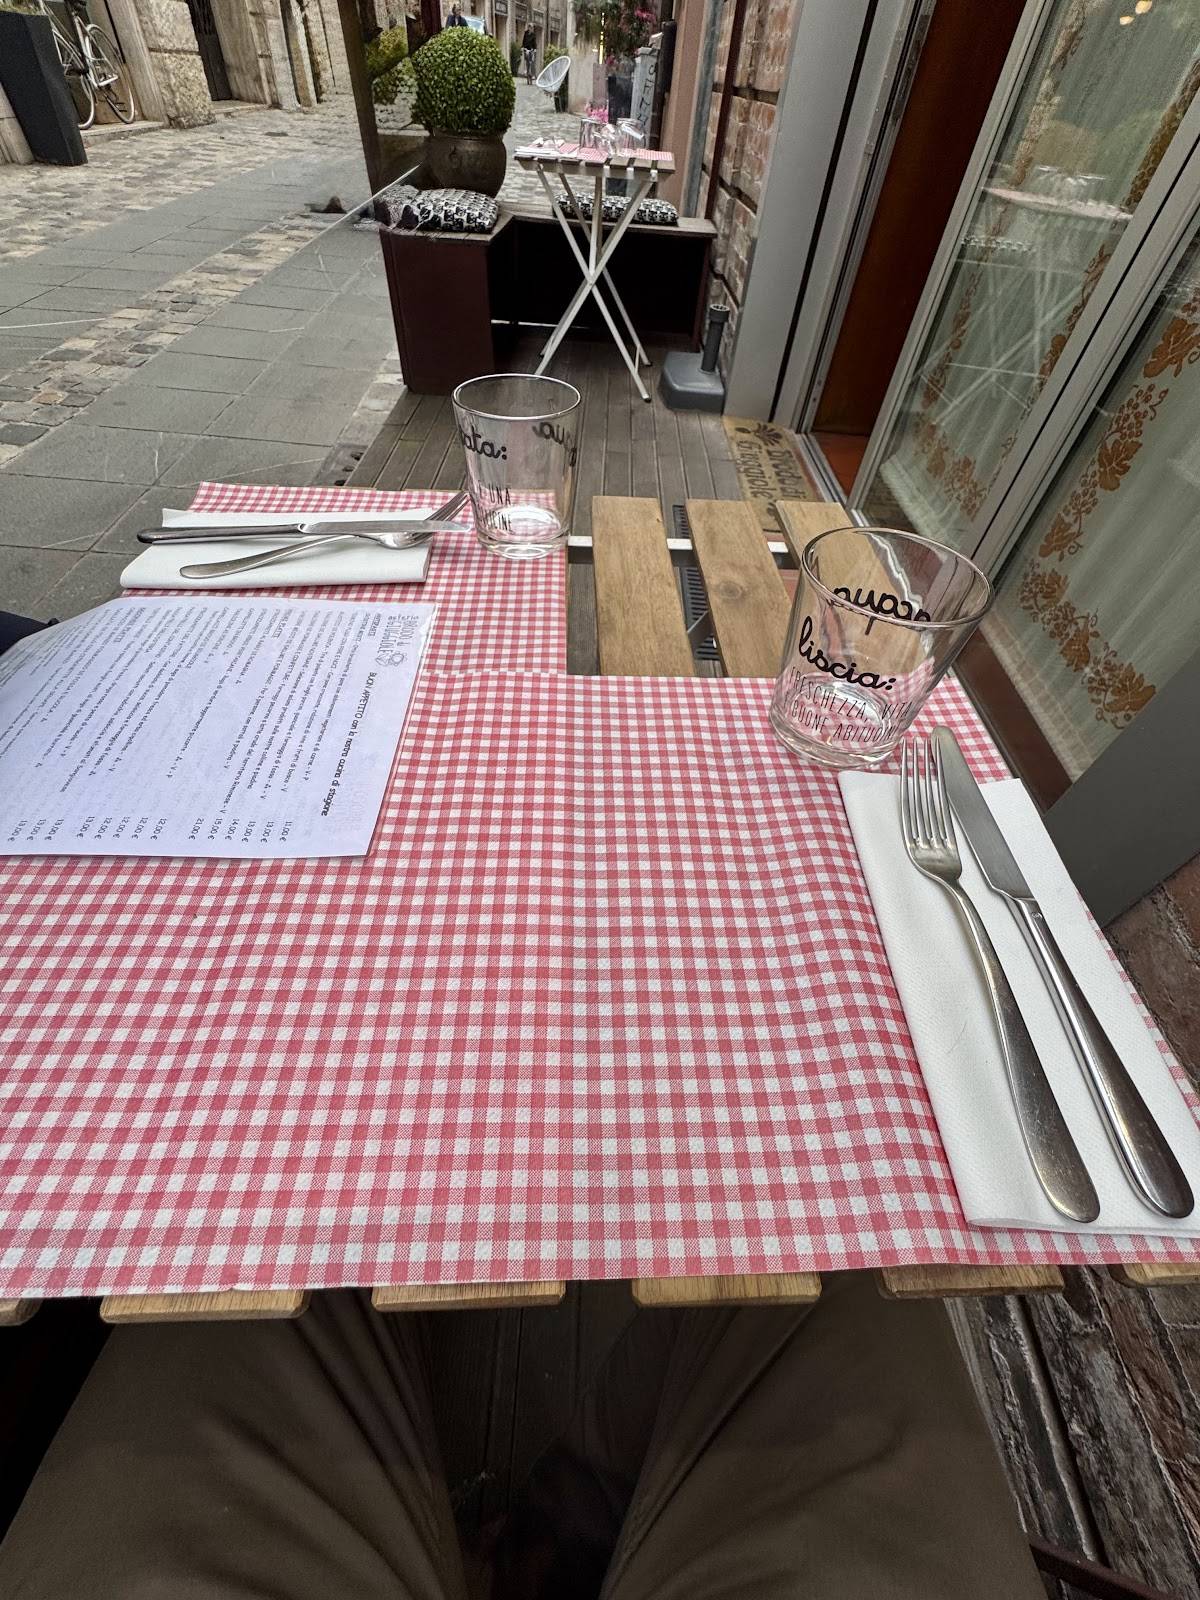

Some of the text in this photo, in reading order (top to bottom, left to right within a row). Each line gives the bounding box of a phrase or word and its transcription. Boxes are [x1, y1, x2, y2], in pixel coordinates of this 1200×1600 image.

[798, 615, 897, 691] liscia:
[364, 672, 377, 688] BUON
[353, 690, 370, 717] APPETITO
[350, 719, 359, 729] con
[340, 737, 354, 756] nostra
[333, 758, 346, 777] cucina
[318, 788, 337, 816] stagione
